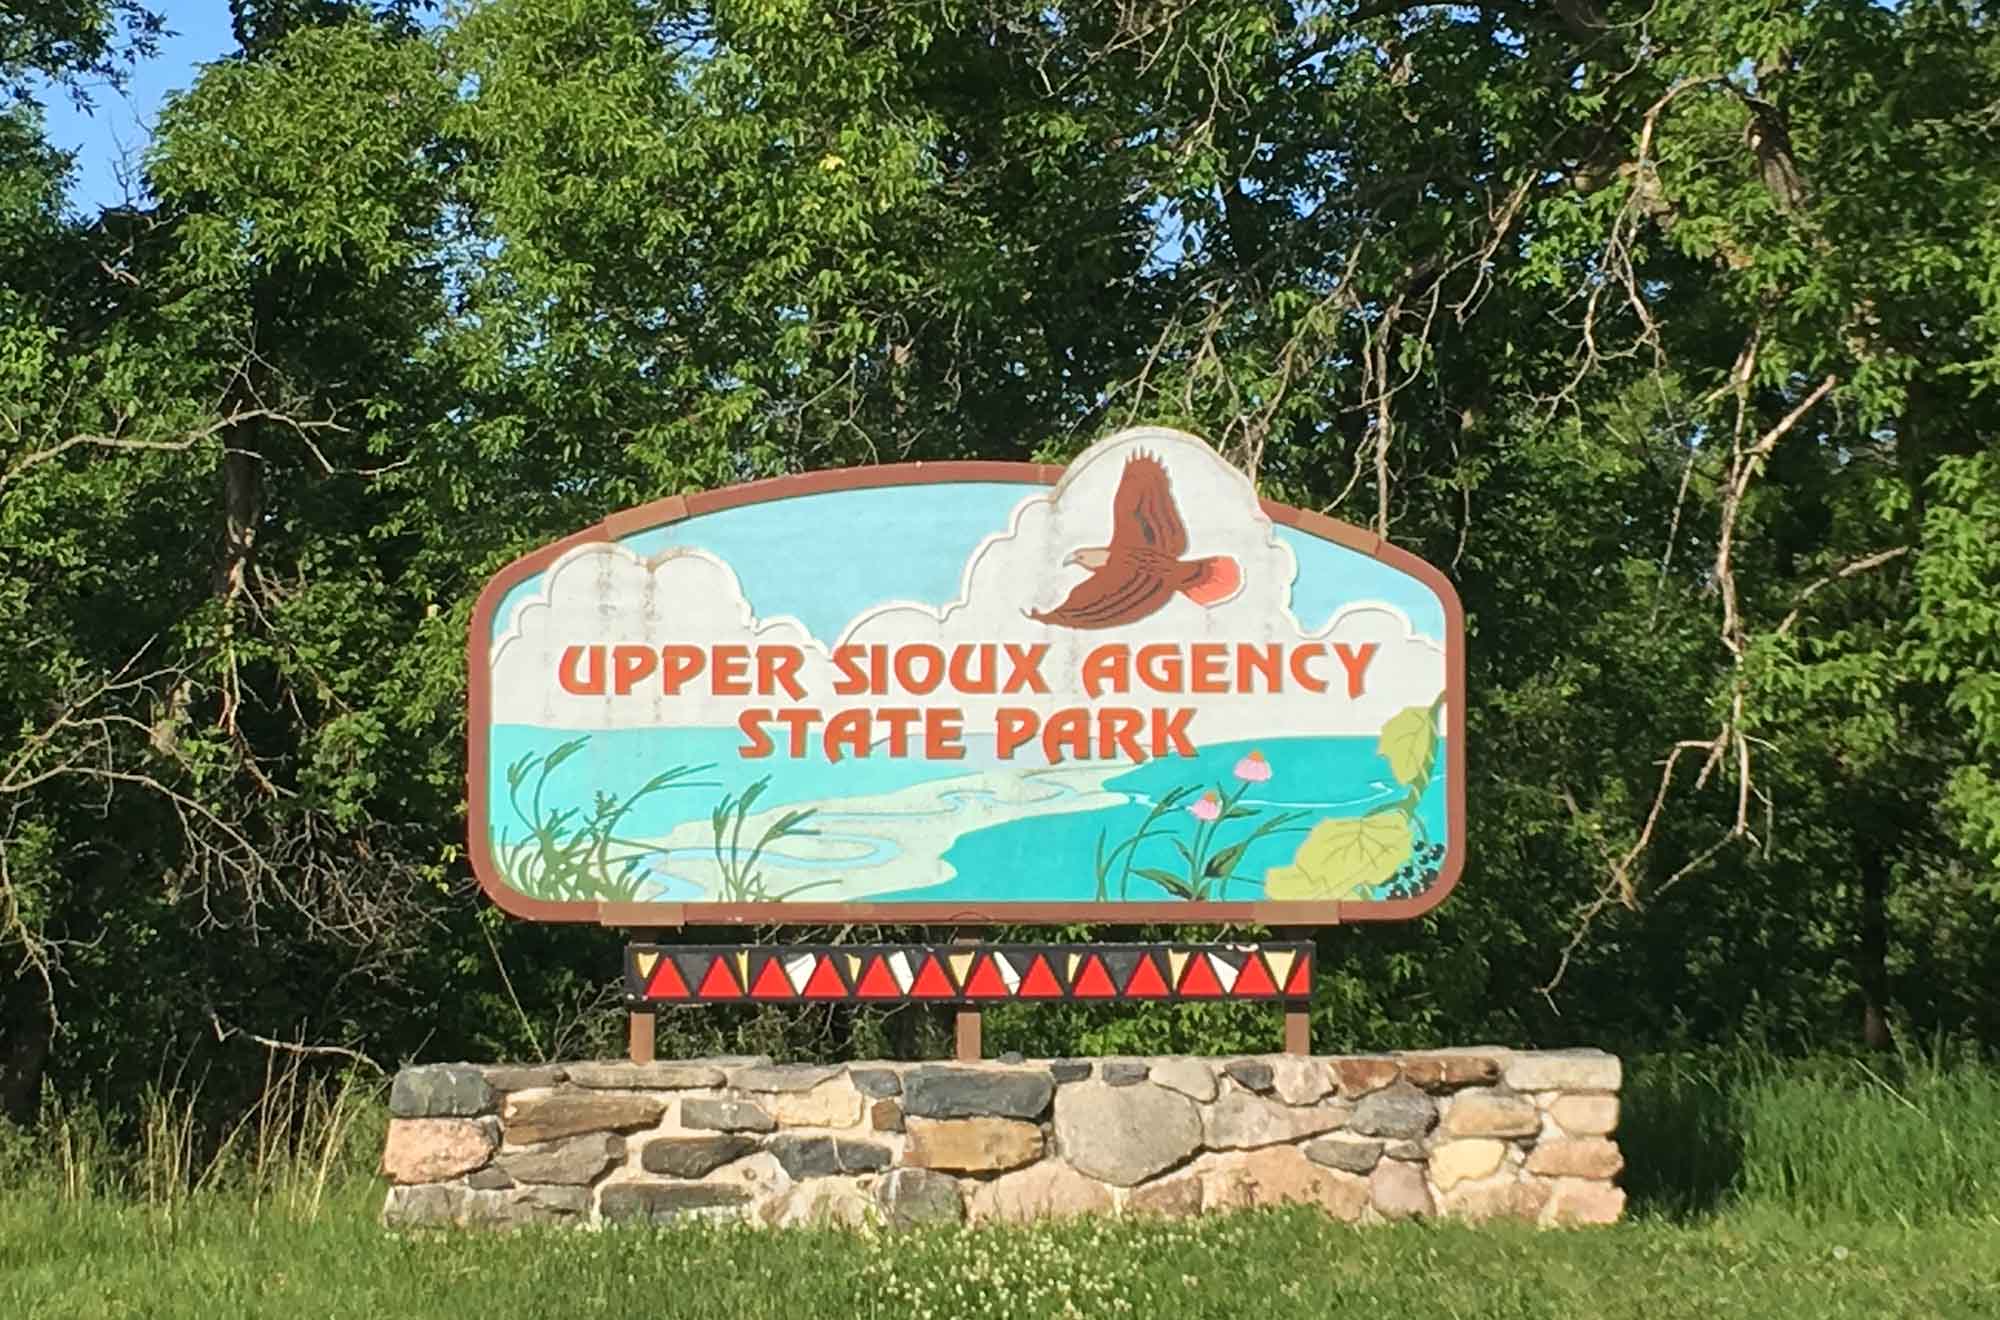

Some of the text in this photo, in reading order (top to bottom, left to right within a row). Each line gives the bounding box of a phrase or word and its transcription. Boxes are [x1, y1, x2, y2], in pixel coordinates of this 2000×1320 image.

[559, 643, 1379, 700] UPPER SIOUX AGENCY
[738, 708, 1198, 763] STATE PARK
